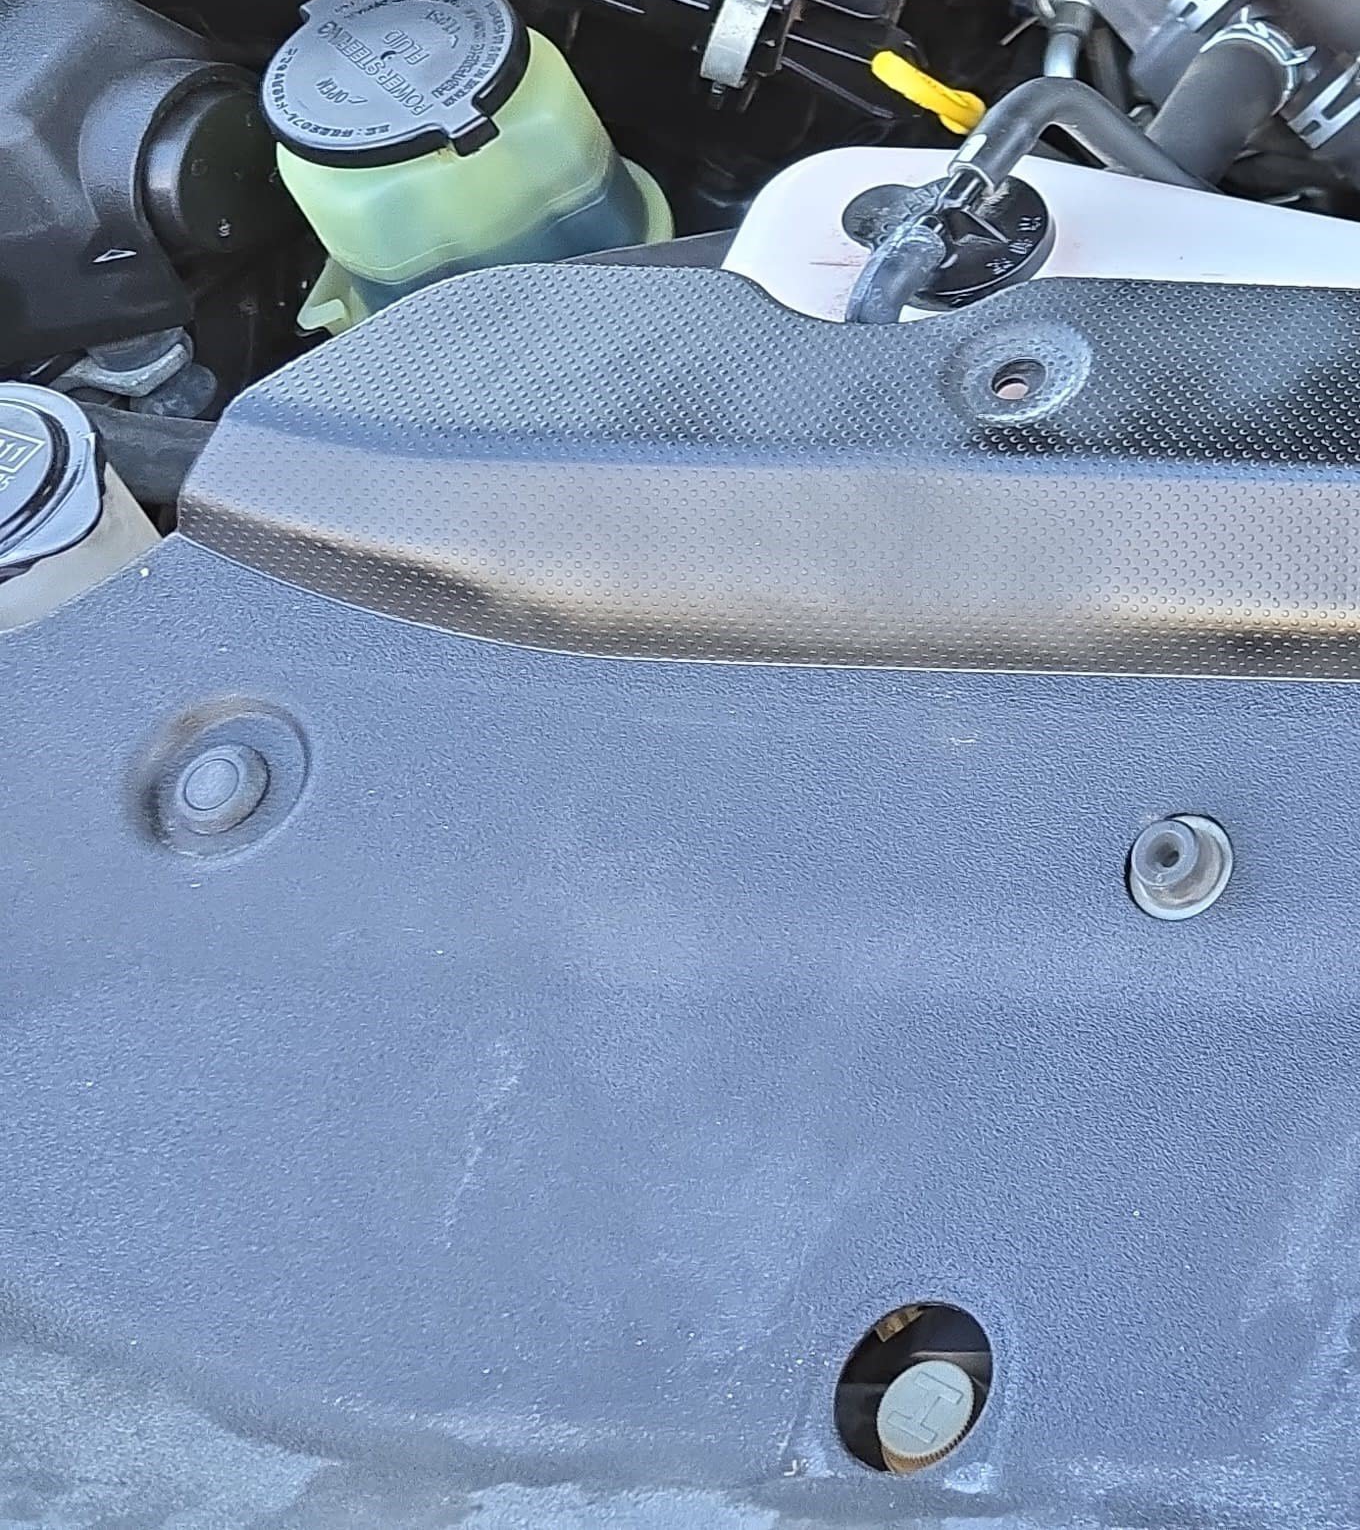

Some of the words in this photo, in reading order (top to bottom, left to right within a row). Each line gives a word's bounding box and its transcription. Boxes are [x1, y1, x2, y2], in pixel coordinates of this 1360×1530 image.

[317, 20, 389, 77] STEERING
[383, 29, 431, 66] FLUID
[315, 77, 349, 104] OPEN
[376, 66, 434, 117] POWER
[0, 437, 28, 462] 11
